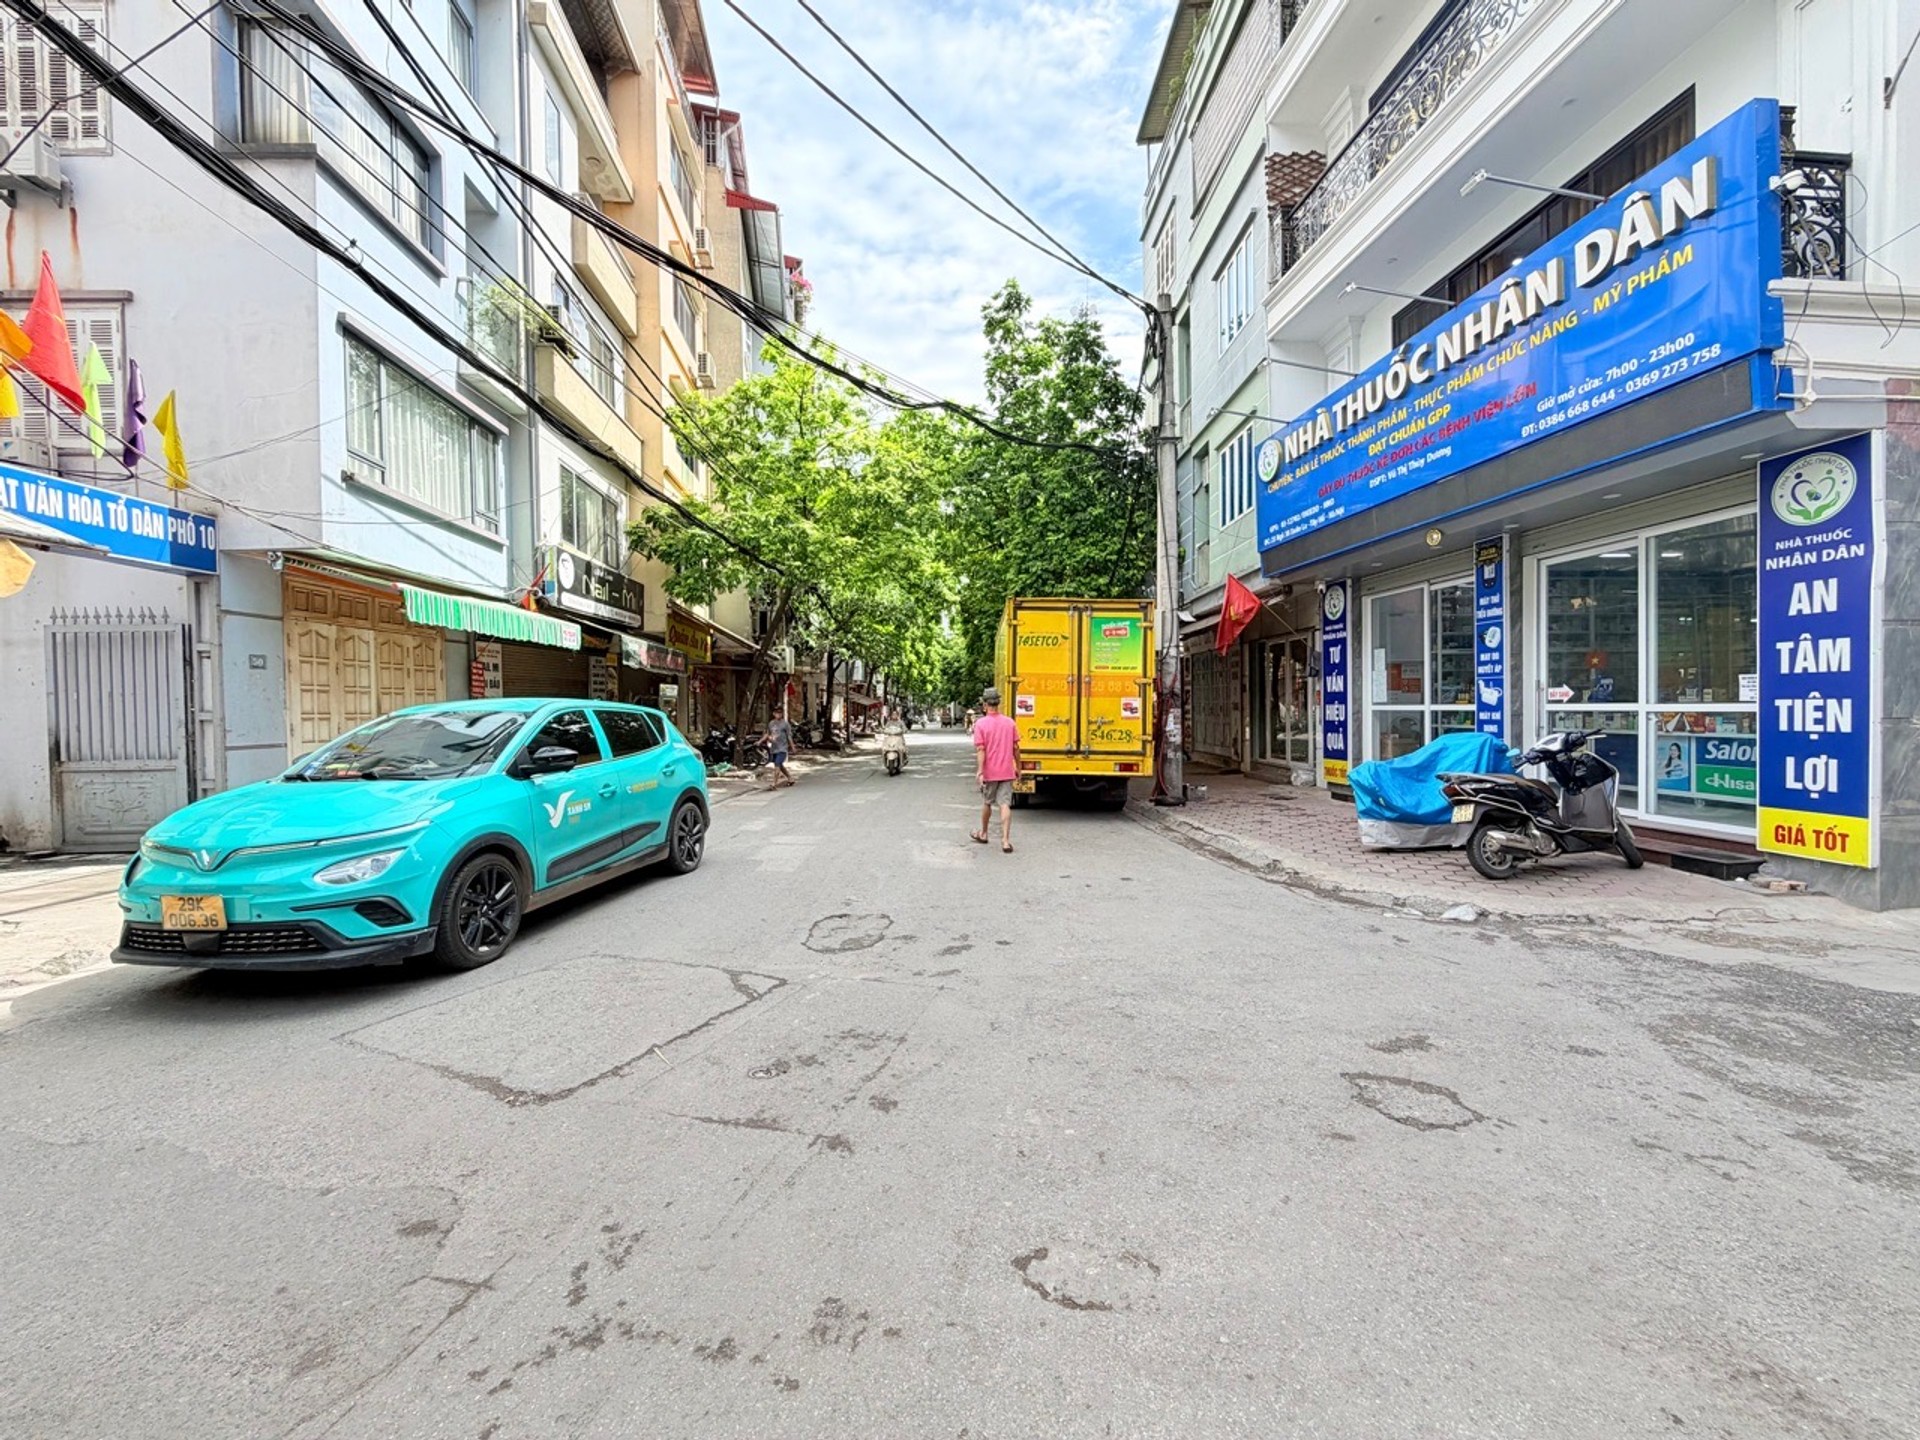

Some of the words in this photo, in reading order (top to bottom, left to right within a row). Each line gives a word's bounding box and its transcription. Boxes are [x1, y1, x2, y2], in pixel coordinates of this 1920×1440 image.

[1284, 408, 1333, 463] NHÀ
[1332, 341, 1430, 432] THUỐC
[1436, 258, 1560, 371] NHÂN
[1575, 156, 1715, 287] DÂN
[1377, 407, 1407, 432] PHẨM
[1414, 386, 1444, 412] THỰC
[1447, 364, 1484, 394] PHẨM
[1487, 338, 1526, 371] CHỨC
[1529, 310, 1578, 348] NĂNG
[1593, 283, 1622, 315] MỸ
[1627, 244, 1693, 296] PHẨM
[1537, 394, 1556, 413] Giờ
[1557, 385, 1576, 404] mở
[1578, 375, 1603, 394] cửa:
[1606, 358, 1638, 382] 7h00
[1649, 332, 1695, 363] 23h00
[1539, 409, 1566, 431] 0386
[1567, 402, 1590, 419] 668
[1591, 388, 1616, 409] 644
[1626, 370, 1659, 393] 0369
[1662, 359, 1688, 379] 273
[1692, 343, 1721, 367] 758
[1389, 416, 1426, 445] CHUẨN
[1428, 404, 1451, 425] GPP
[24, 480, 63, 519] VĂN
[67, 488, 104, 527] HÓA
[107, 493, 128, 533] TỔ
[132, 507, 164, 541] DÂN
[168, 513, 196, 546] PHỐ
[200, 524, 216, 550] 10
[1766, 550, 1817, 570] NHÂN
[1822, 543, 1865, 562] DÂN
[1775, 537, 1802, 551] NHÀ
[1805, 527, 1852, 545] THUỐC
[1788, 577, 1838, 616] AN
[1329, 644, 1341, 664] TƯ
[1776, 633, 1851, 674] TÂM
[1326, 669, 1344, 692] VẤN
[1326, 701, 1345, 725] HIỆU
[1775, 691, 1852, 740] TIỆN
[1327, 727, 1345, 751] QUẢ
[1785, 754, 1838, 798] LỢI
[1774, 823, 1807, 847] GIÁ
[1812, 825, 1850, 853] TỐT
[169, 913, 219, 928] 006.36
[178, 897, 204, 911] 29K
